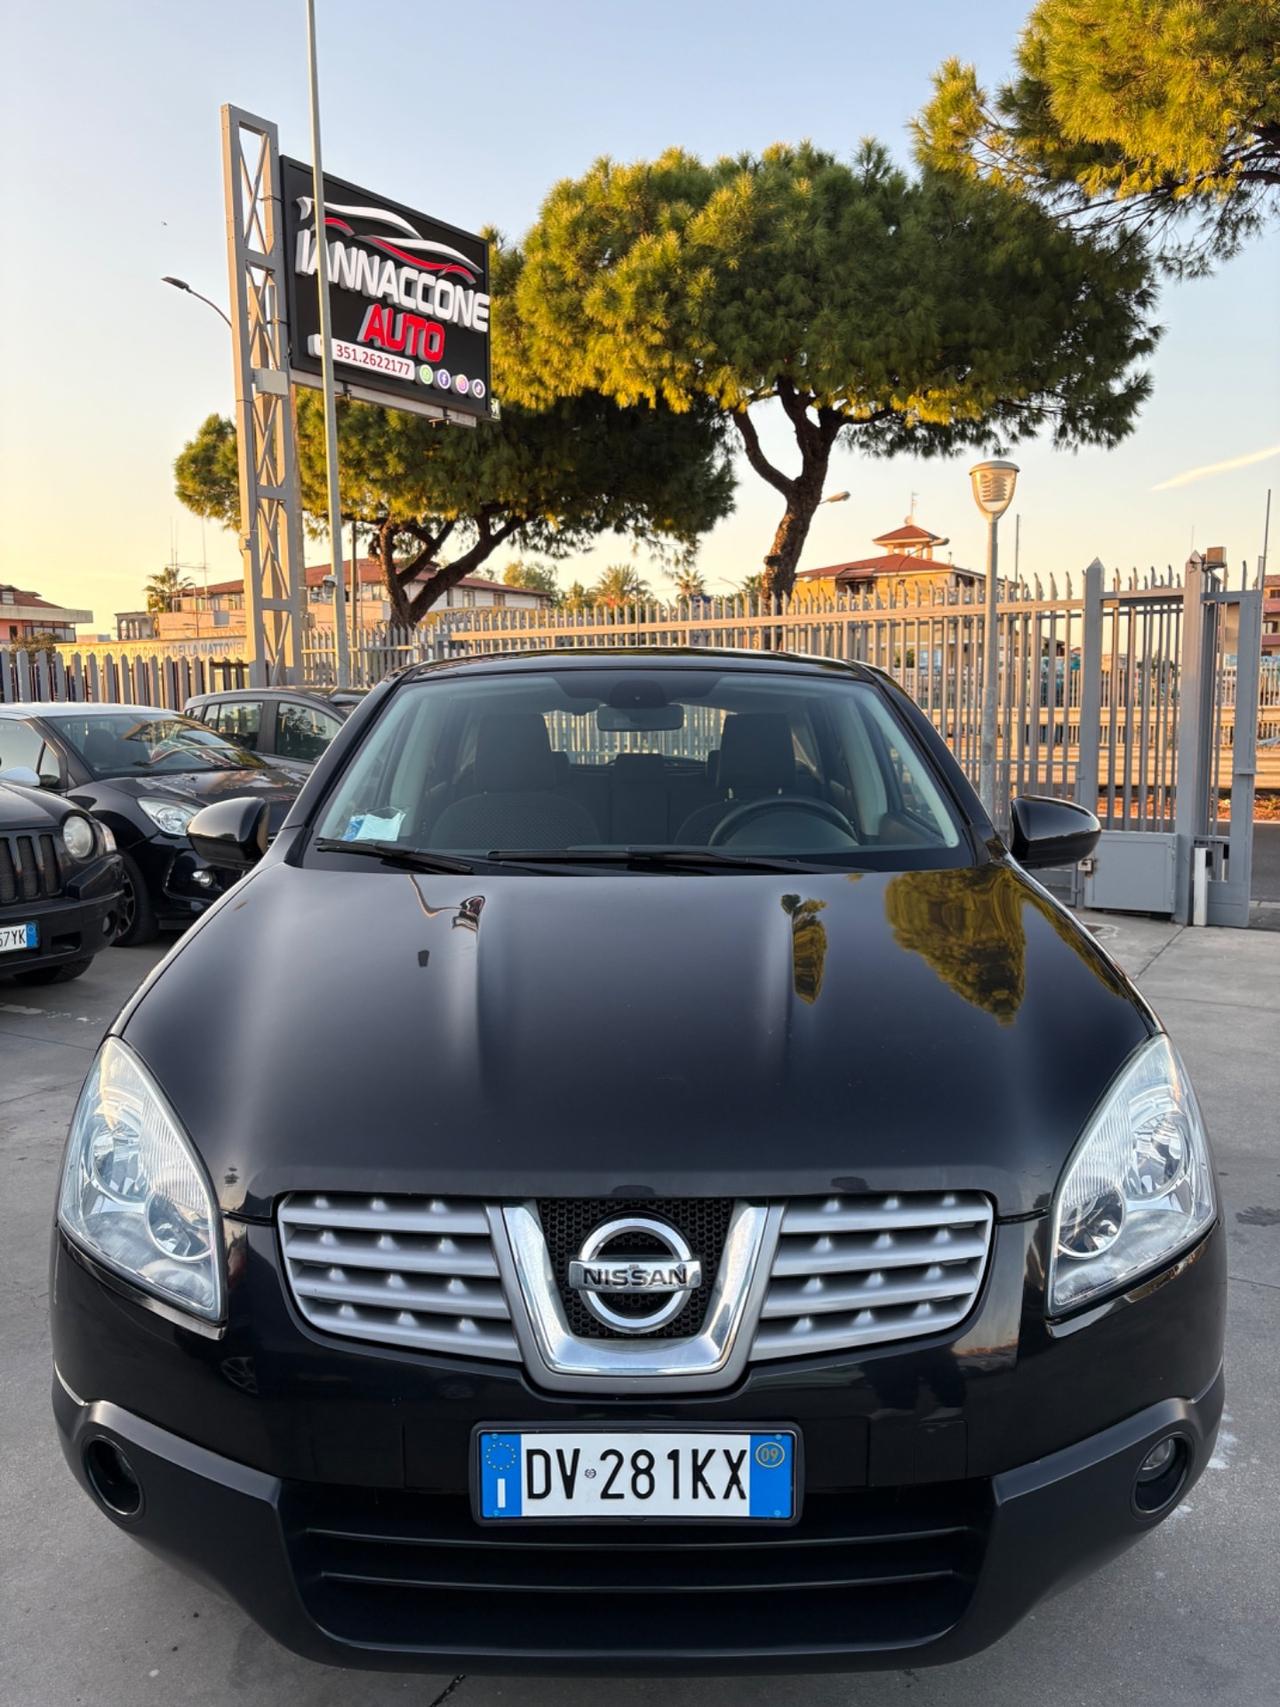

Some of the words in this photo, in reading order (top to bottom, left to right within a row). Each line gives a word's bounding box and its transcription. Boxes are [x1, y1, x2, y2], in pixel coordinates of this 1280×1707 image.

[296, 229, 490, 333] IANNACCONE
[336, 344, 411, 376] 351.2622177
[358, 303, 446, 362] AUTO
[583, 1266, 688, 1286] NISSAN
[497, 1478, 506, 1508] I
[526, 1448, 581, 1500] DV
[600, 1449, 748, 1500] 281KX
[760, 1447, 779, 1463] 09
